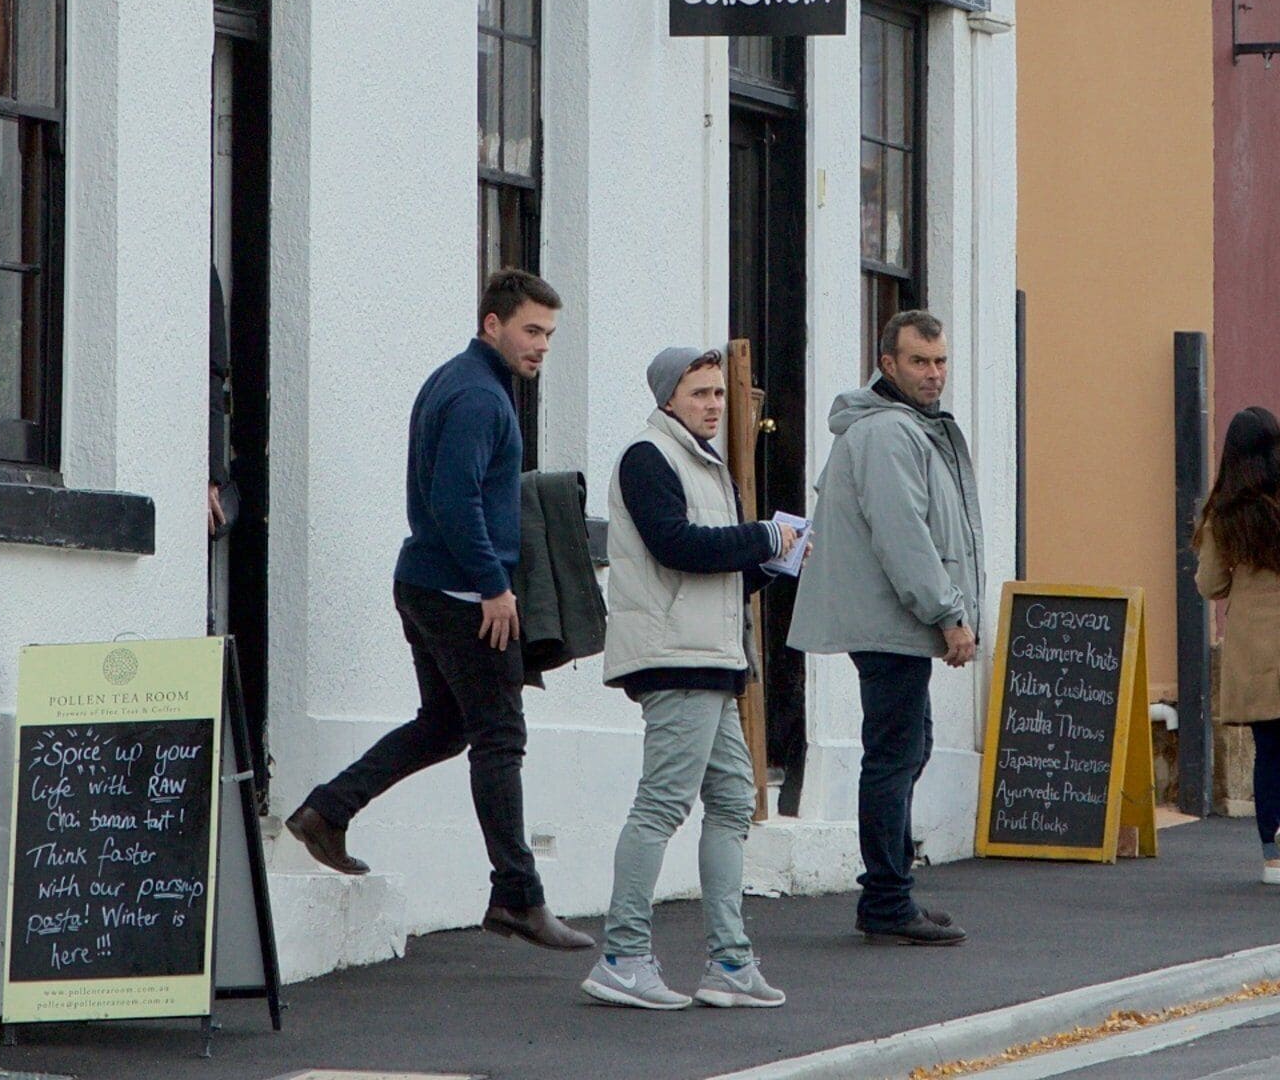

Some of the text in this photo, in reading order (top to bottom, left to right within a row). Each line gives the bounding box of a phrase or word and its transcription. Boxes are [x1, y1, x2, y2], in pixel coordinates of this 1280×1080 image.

[1026, 603, 1111, 631] Caravan
[1012, 635, 1119, 671] Cashmere Knits
[49, 691, 190, 707] POLLEN TEA ROOM
[1009, 670, 1114, 705] Kilim Cushions
[1005, 706, 1105, 742] Kantha Throws
[43, 742, 202, 777] Spice up your
[999, 748, 1111, 774] Japanese Incense
[31, 774, 187, 810] life with RAW
[996, 779, 1060, 807] Ayurvedic
[89, 809, 138, 832] banana
[996, 810, 1069, 835] Print Blocks
[26, 836, 157, 877] Think faster
[38, 874, 204, 908] with our parsnip
[102, 902, 161, 928] Winter
[172, 910, 185, 928] is
